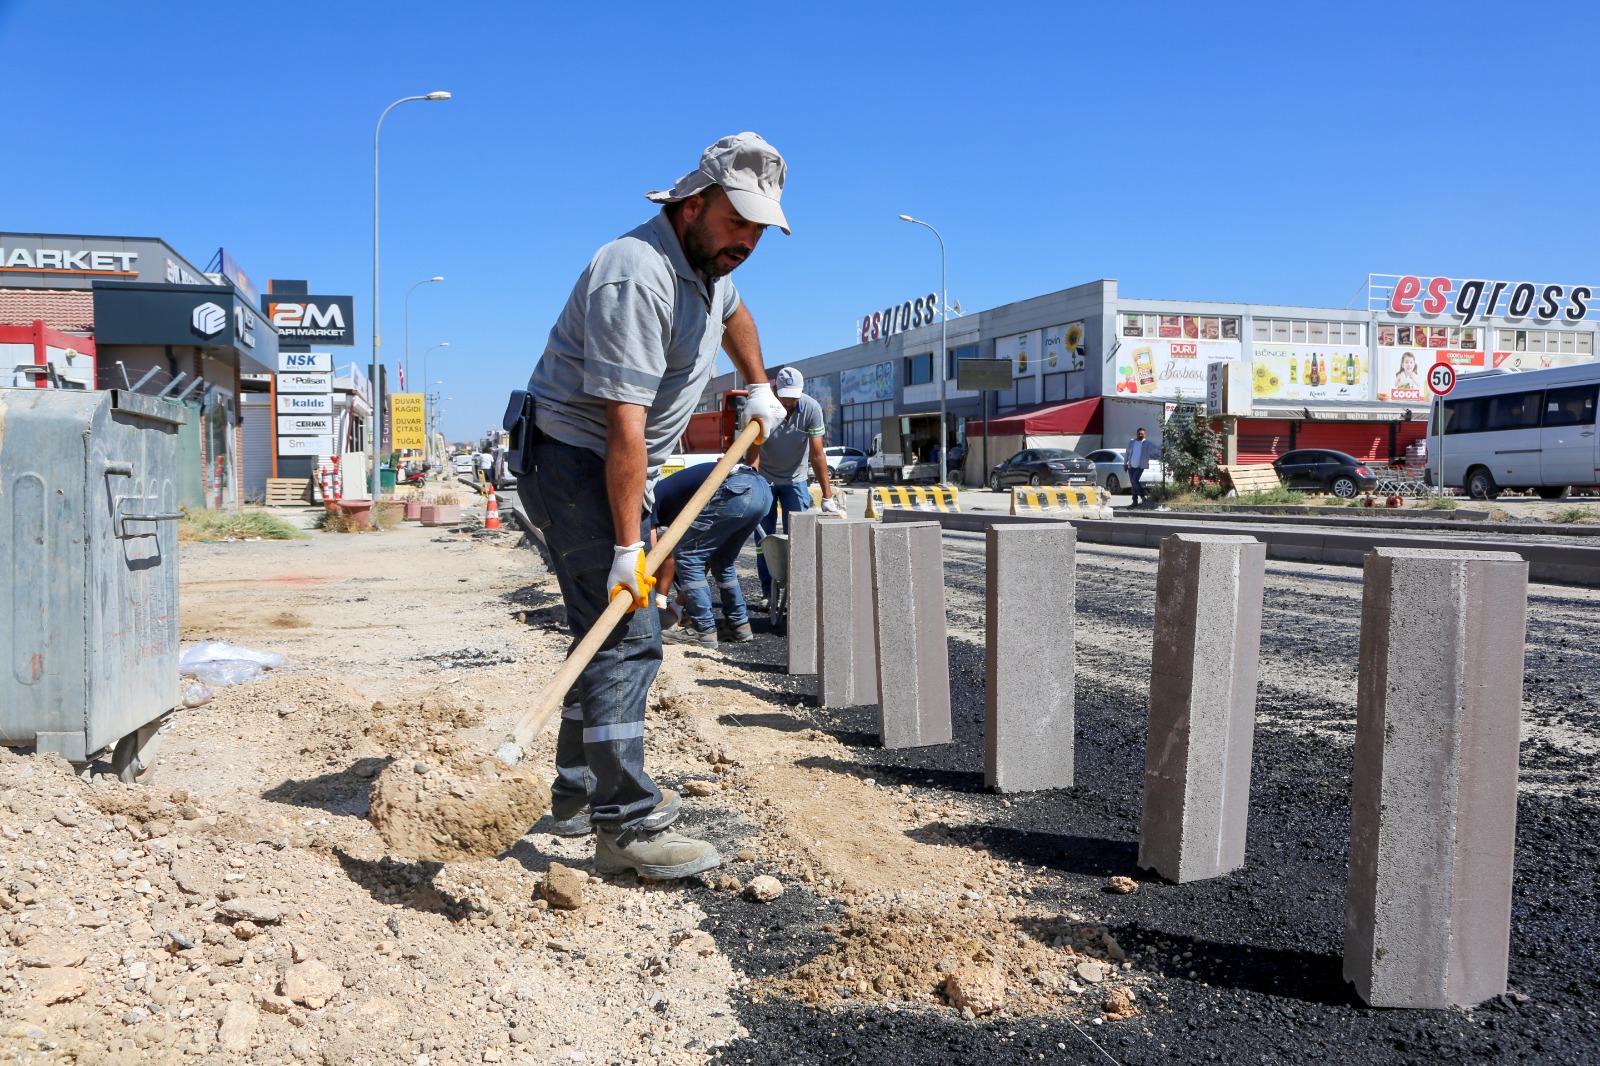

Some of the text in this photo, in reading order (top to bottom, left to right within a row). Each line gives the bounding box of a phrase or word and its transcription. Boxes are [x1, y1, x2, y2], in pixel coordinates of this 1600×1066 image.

[1391, 275, 1592, 327] esgross
[273, 303, 345, 328] 2M
[861, 292, 937, 346] esgross
[278, 328, 296, 336] API
[1172, 345, 1196, 354] DURU
[286, 355, 316, 365] NSK
[1433, 371, 1451, 386] 50
[1393, 390, 1419, 399] COOK
[293, 399, 324, 407] kalde
[396, 437, 421, 445] TUĞLA
